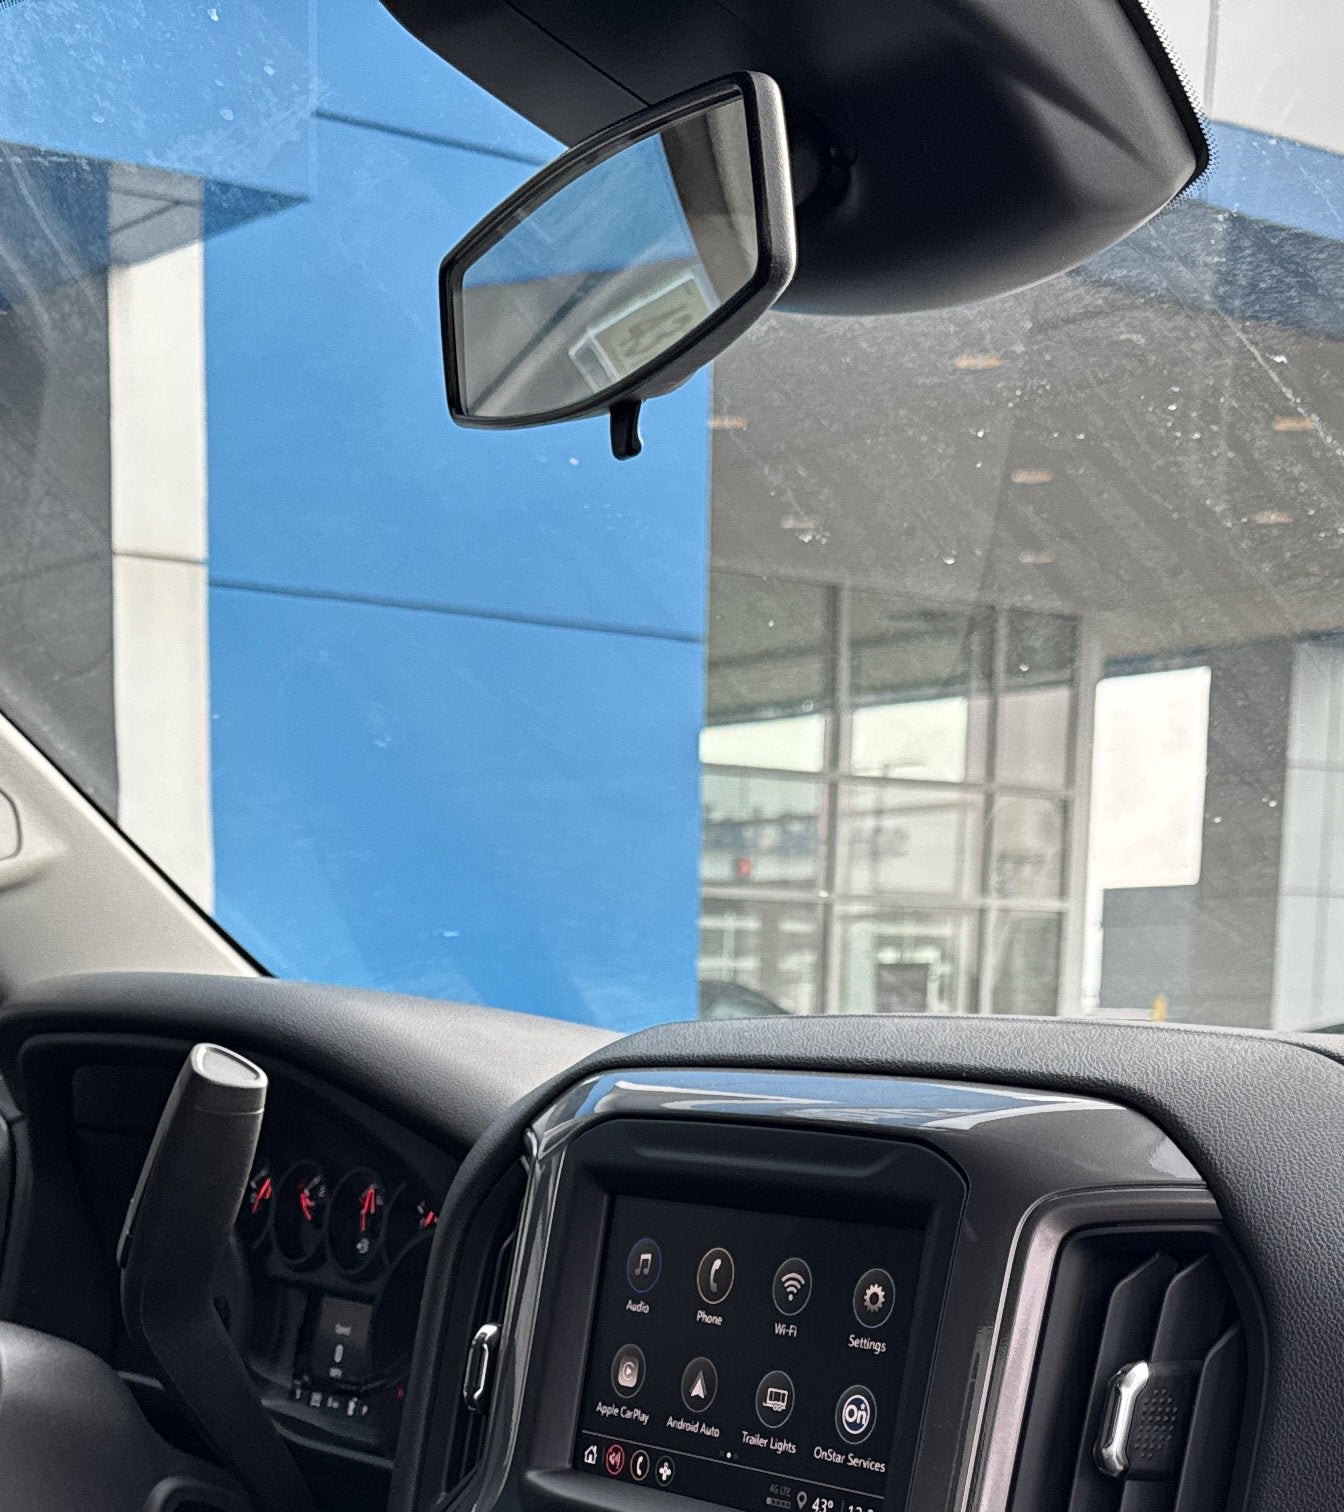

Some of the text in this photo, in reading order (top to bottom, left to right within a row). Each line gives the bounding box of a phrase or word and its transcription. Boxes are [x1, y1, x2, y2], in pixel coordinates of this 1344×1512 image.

[625, 1299, 649, 1313] Audio
[696, 1309, 723, 1326] Phone
[774, 1322, 797, 1338] Wi-Fi
[847, 1334, 887, 1355] Settings
[596, 1401, 650, 1426] Apple CarPlay
[666, 1415, 721, 1438] Android Auto
[741, 1430, 796, 1454] Trailer Lights
[813, 1446, 886, 1473] OnStar Services
